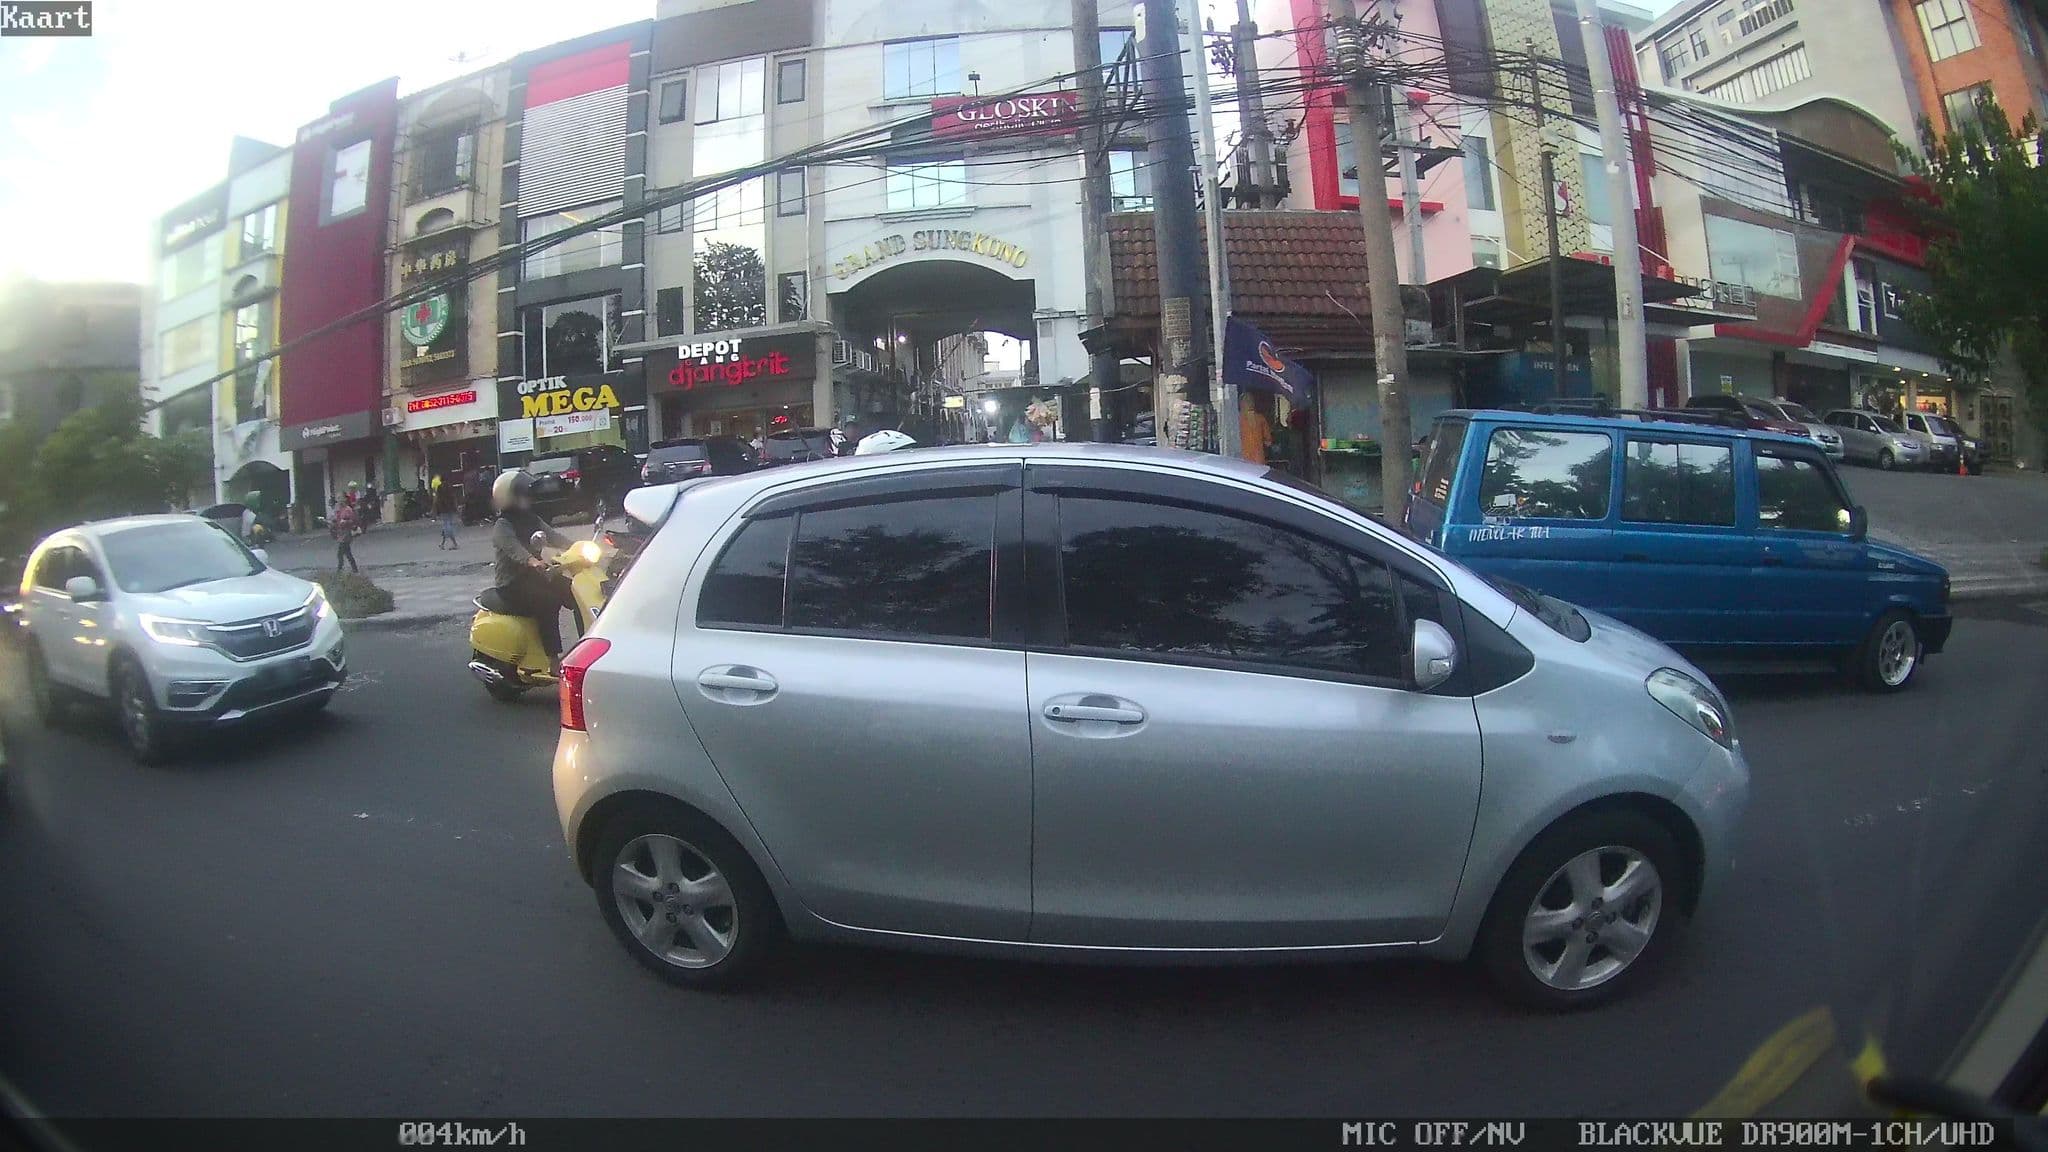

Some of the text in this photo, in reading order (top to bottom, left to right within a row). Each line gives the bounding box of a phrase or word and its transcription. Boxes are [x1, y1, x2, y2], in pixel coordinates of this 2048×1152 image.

[832, 234, 906, 280] GRAND
[678, 338, 742, 360] DEPOT
[517, 375, 567, 395] OPTIK
[521, 384, 620, 419] MEGA
